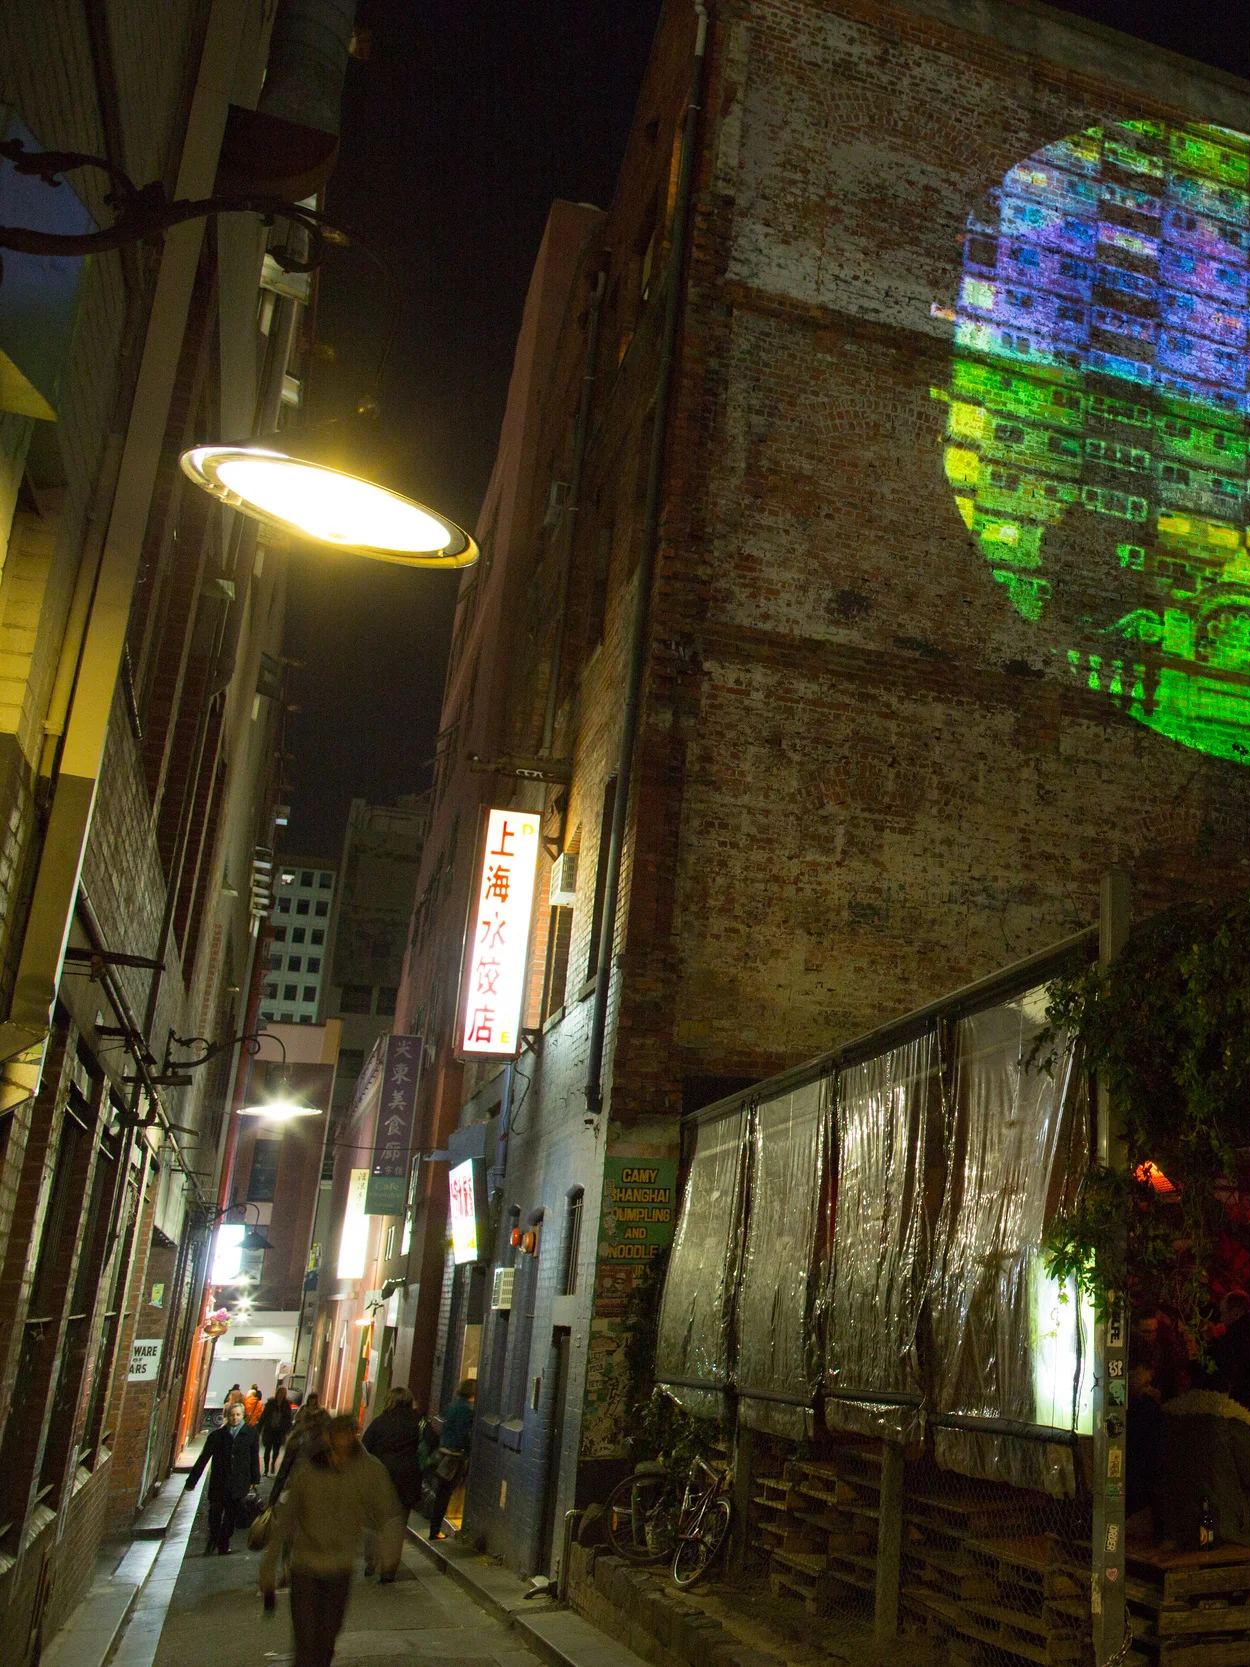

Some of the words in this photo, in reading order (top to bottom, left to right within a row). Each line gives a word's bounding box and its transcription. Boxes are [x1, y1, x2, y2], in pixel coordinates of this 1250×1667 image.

[467, 821, 515, 1043] 上海水饺店
[622, 1168, 659, 1183] CAMY
[624, 1227, 647, 1239] AND
[134, 1346, 158, 1356] WARE
[129, 1363, 147, 1374] ARS
